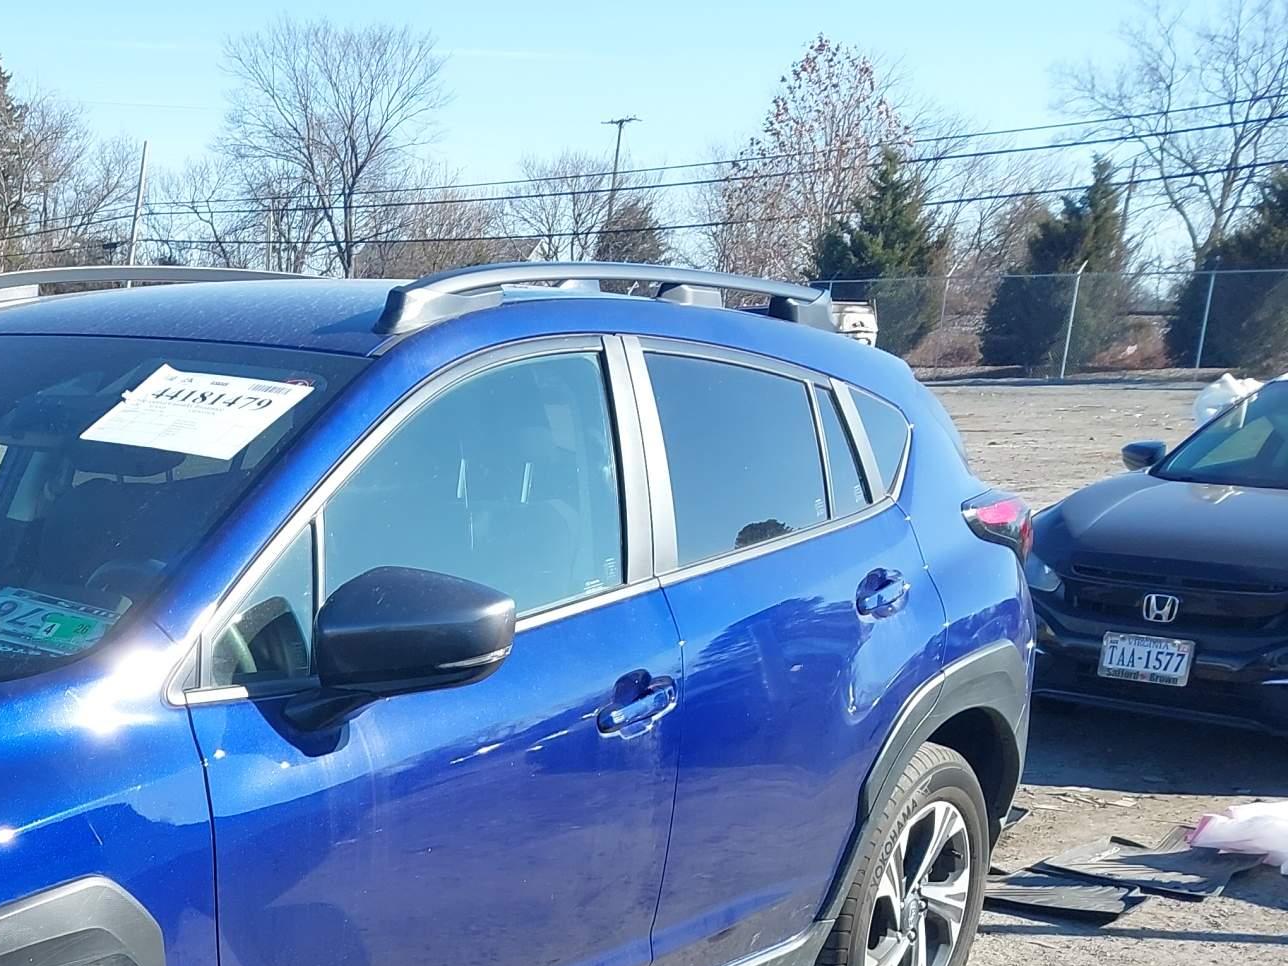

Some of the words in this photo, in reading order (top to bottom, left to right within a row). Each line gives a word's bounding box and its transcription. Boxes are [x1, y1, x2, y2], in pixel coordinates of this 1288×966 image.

[152, 387, 272, 411] 44181479
[44, 624, 57, 636] 4
[74, 624, 90, 635] 26
[1128, 637, 1169, 649] VIRGINIA
[1108, 645, 1186, 673] TAA-1577
[870, 799, 918, 888] YOKOHAMA
